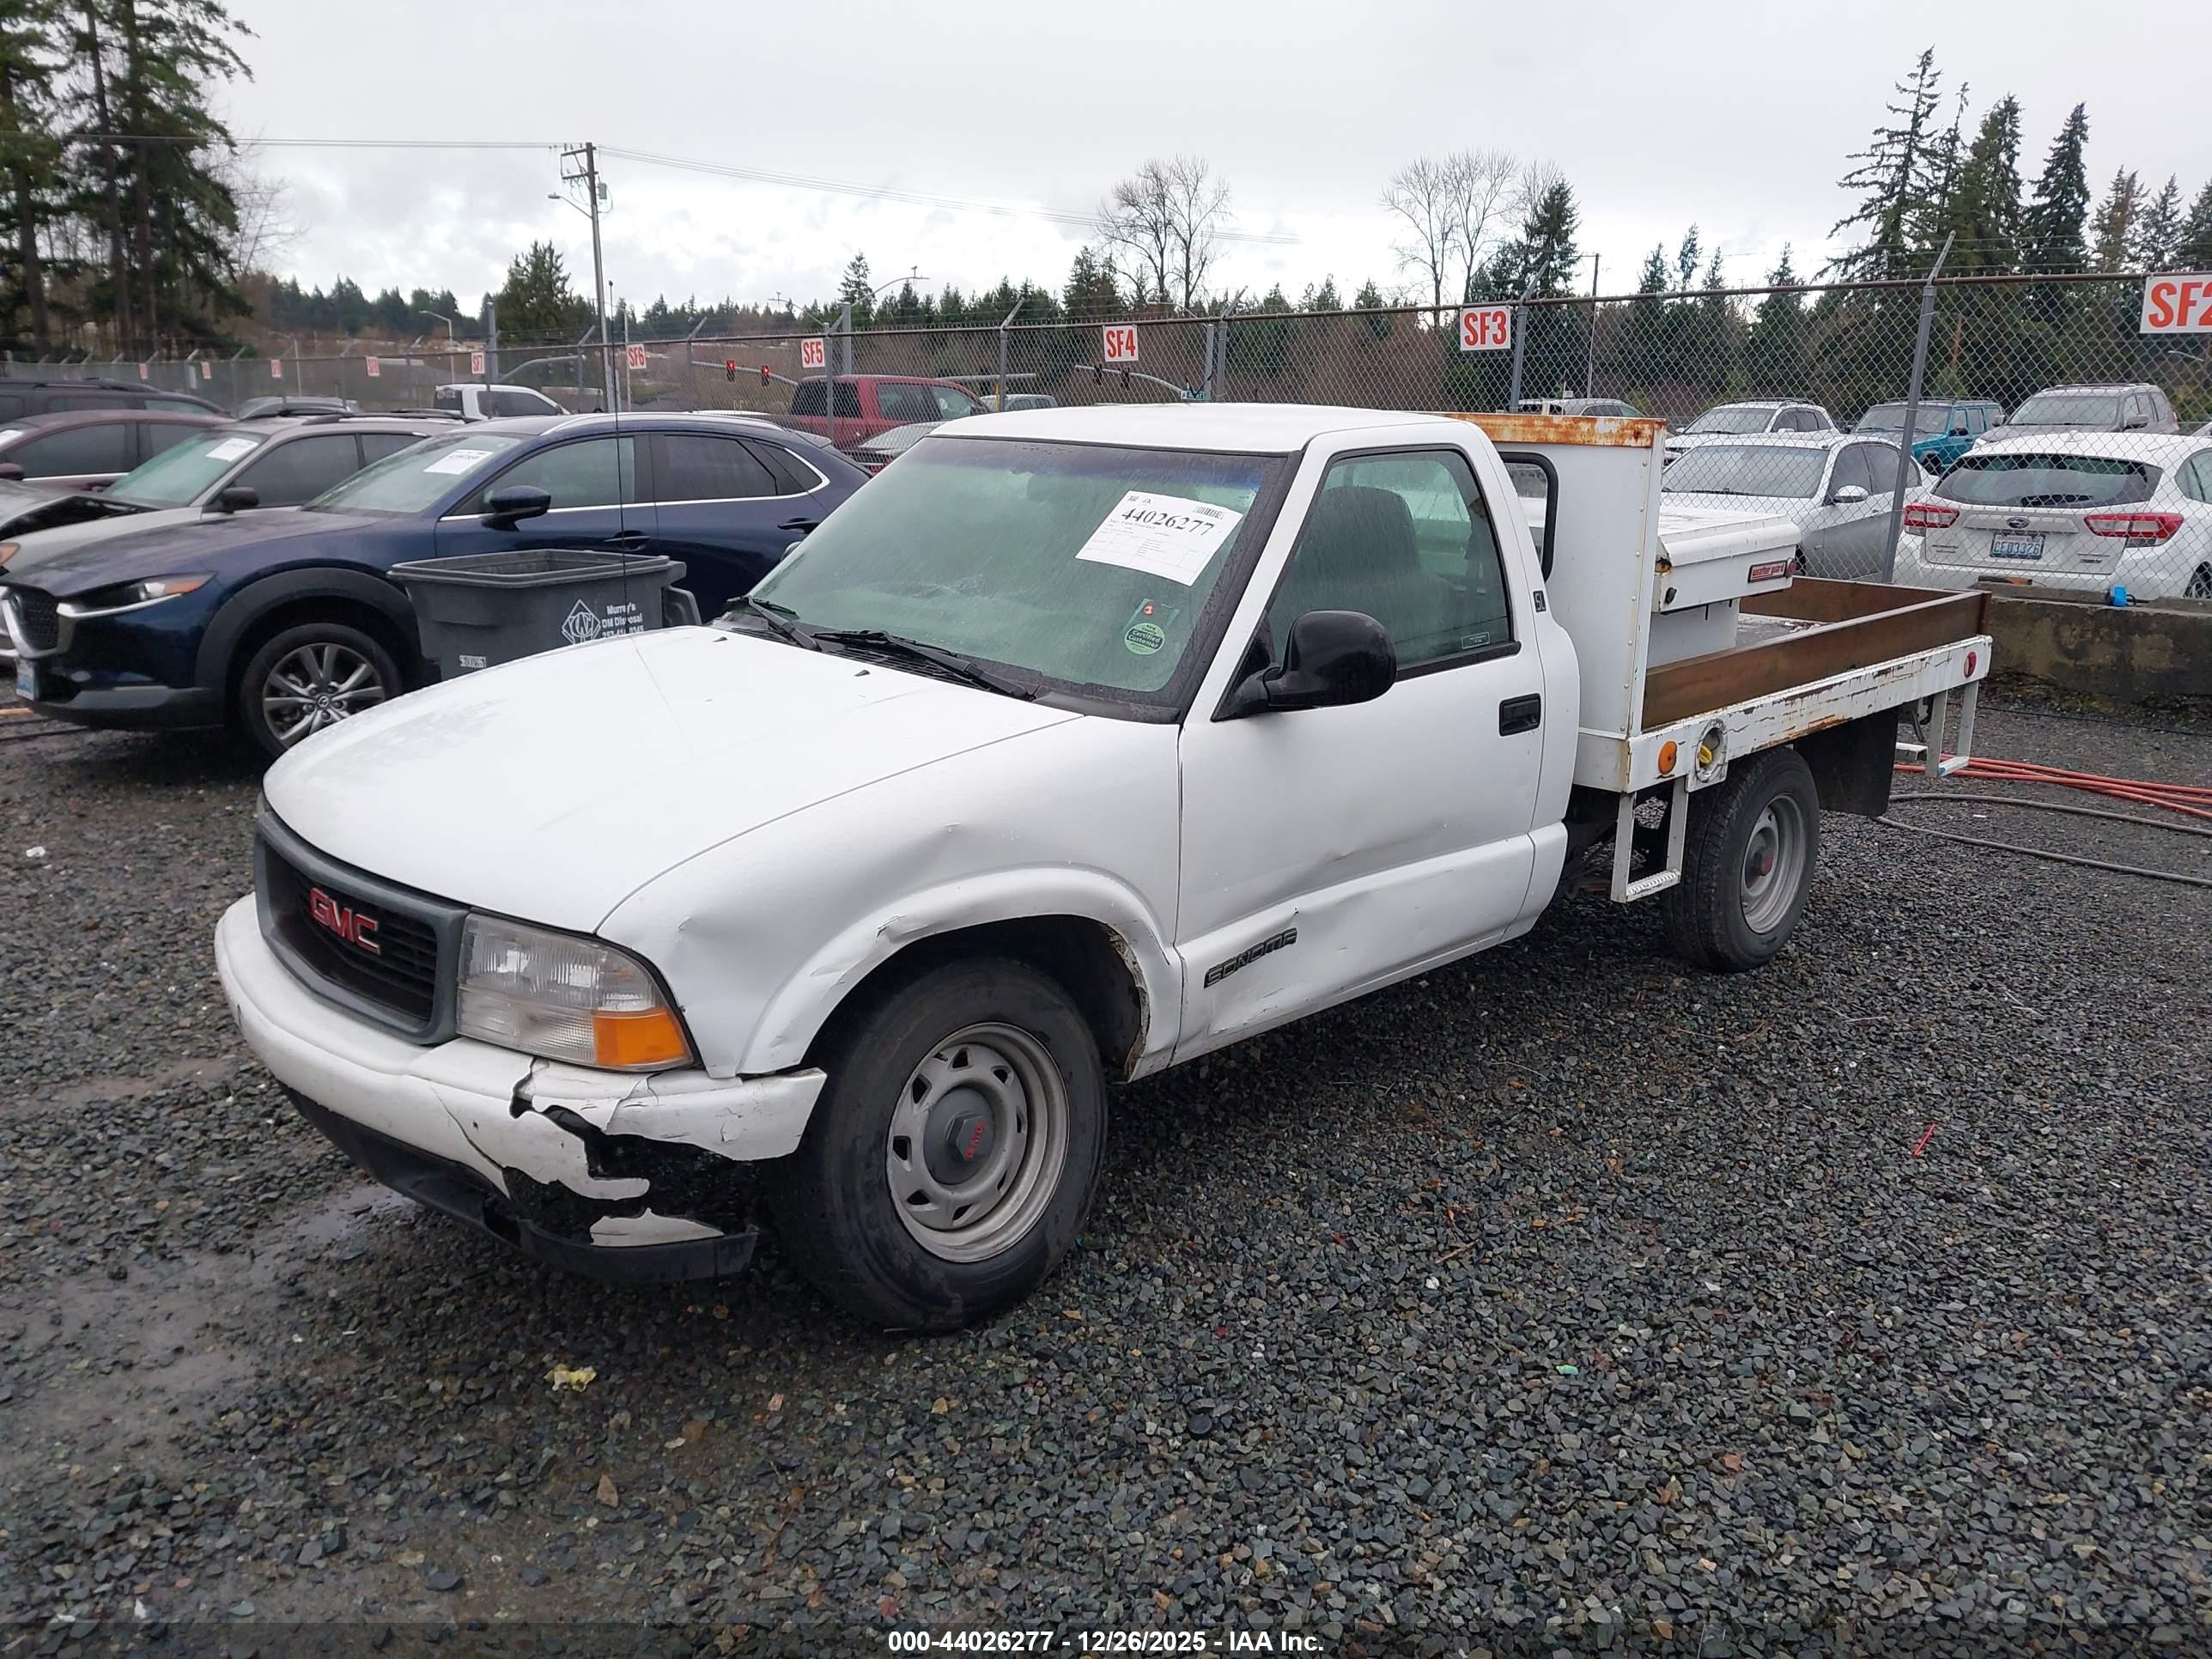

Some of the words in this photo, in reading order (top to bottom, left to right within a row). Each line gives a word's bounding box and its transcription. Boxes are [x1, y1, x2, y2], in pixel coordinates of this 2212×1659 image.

[1464, 311, 1506, 346] SF3
[803, 341, 823, 364] SF5
[1106, 330, 1135, 358] SF4
[472, 355, 483, 372] SF7
[629, 346, 645, 367] SF6
[1121, 508, 1215, 536] 44026277
[602, 618, 614, 628] DM
[615, 613, 643, 625] Disposal
[1128, 635, 1159, 648] Customer
[1132, 629, 1160, 642] Certified
[310, 887, 381, 955] GMC
[1204, 927, 1297, 989] SONOMA
